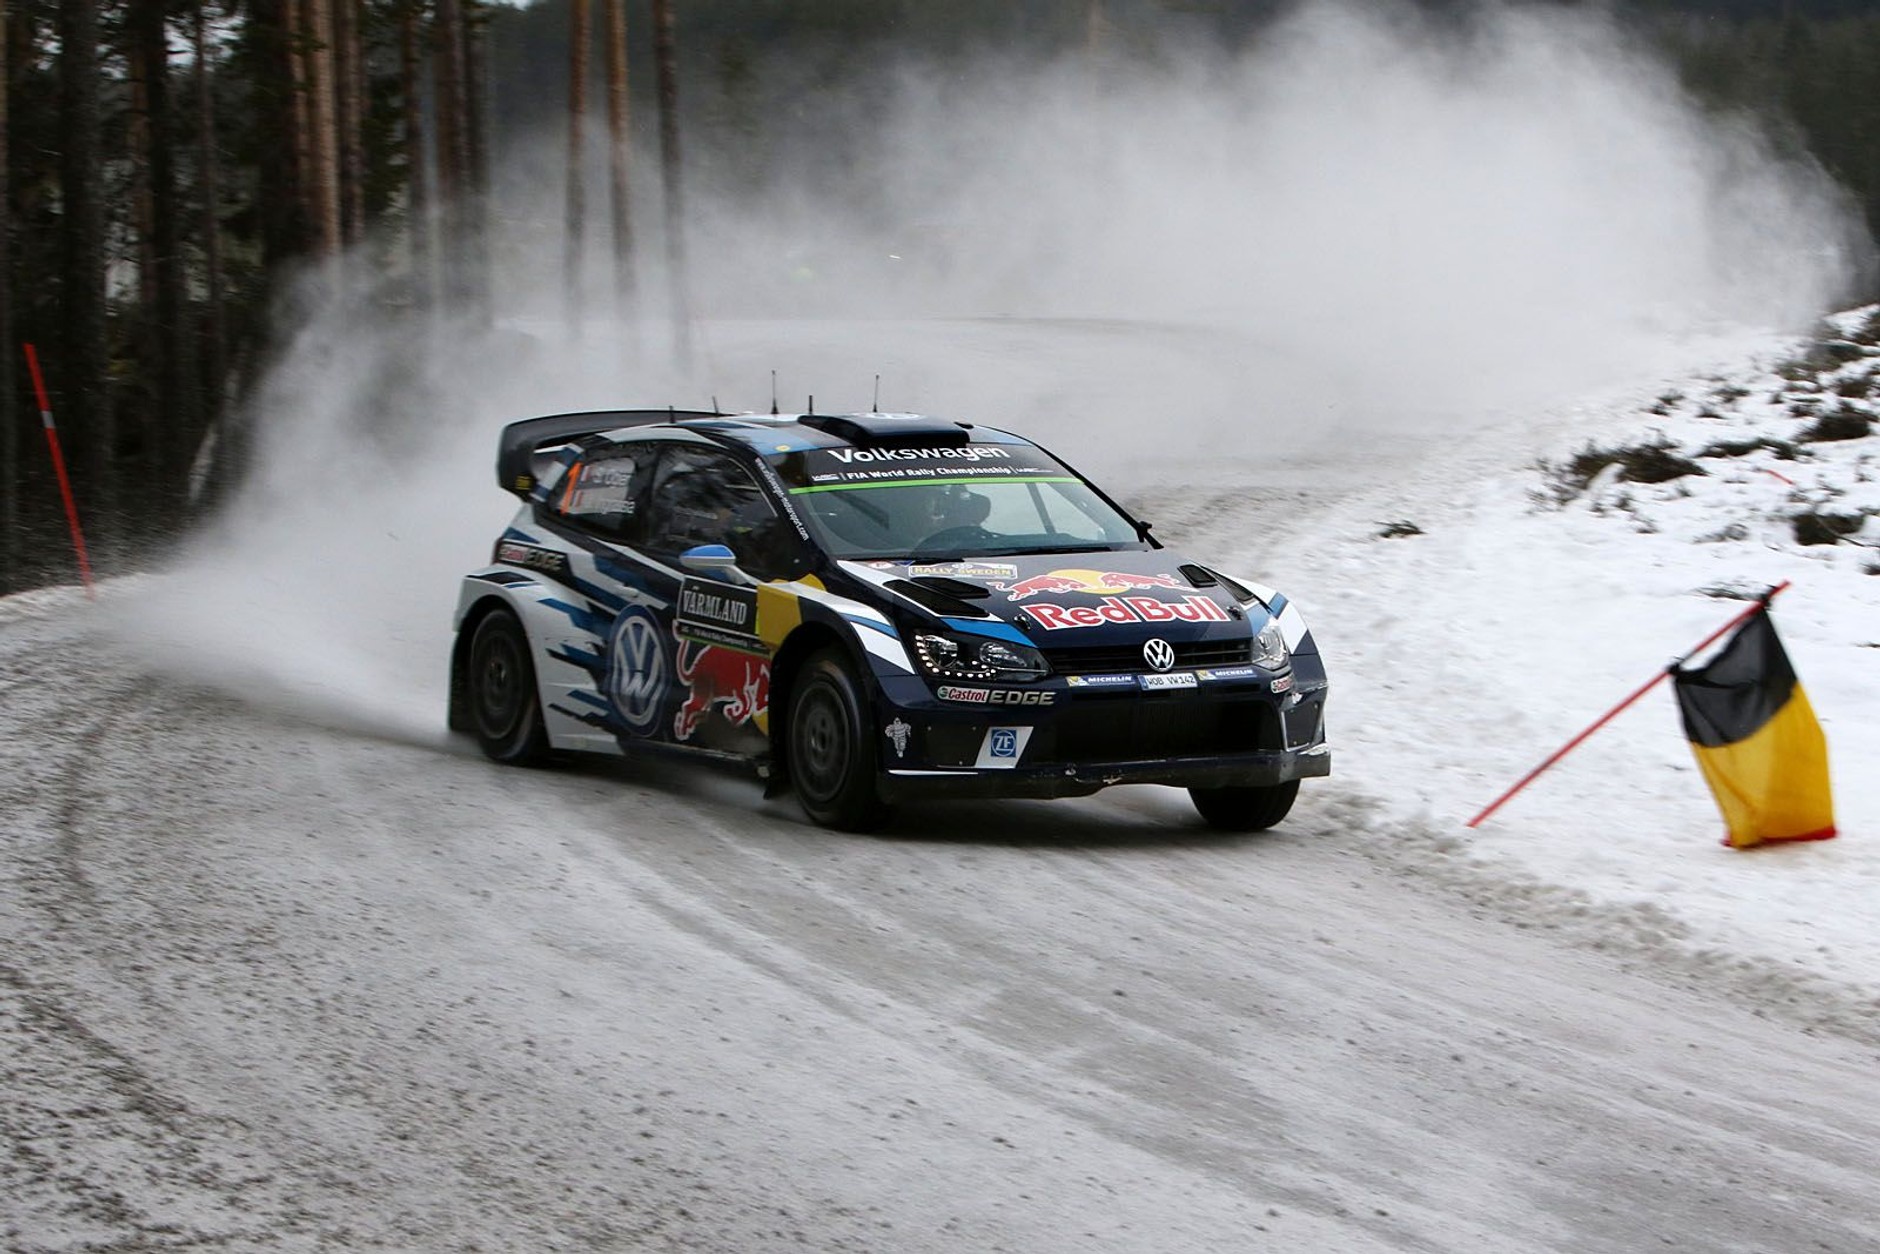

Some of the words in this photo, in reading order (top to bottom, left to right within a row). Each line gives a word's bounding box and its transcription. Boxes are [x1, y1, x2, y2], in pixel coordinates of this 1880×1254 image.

[827, 447, 1011, 463] Volkswagen
[846, 472, 869, 480] FIA
[868, 469, 905, 479] World
[905, 468, 936, 476] Rally
[936, 466, 1012, 475] Championship
[560, 461, 583, 515] 1
[914, 566, 953, 574] RALLY
[957, 567, 1012, 576] SWEDEN
[683, 586, 747, 625] VÄRMLAND
[1022, 597, 1141, 630] Red
[1122, 596, 1230, 622] Bull
[1087, 675, 1132, 683] MICHELIN
[1214, 668, 1254, 677] MICHELIN
[1147, 676, 1165, 686] WOB
[948, 687, 986, 701] Castrol
[988, 690, 1057, 706] EDGE
[994, 735, 1014, 752] ZF
